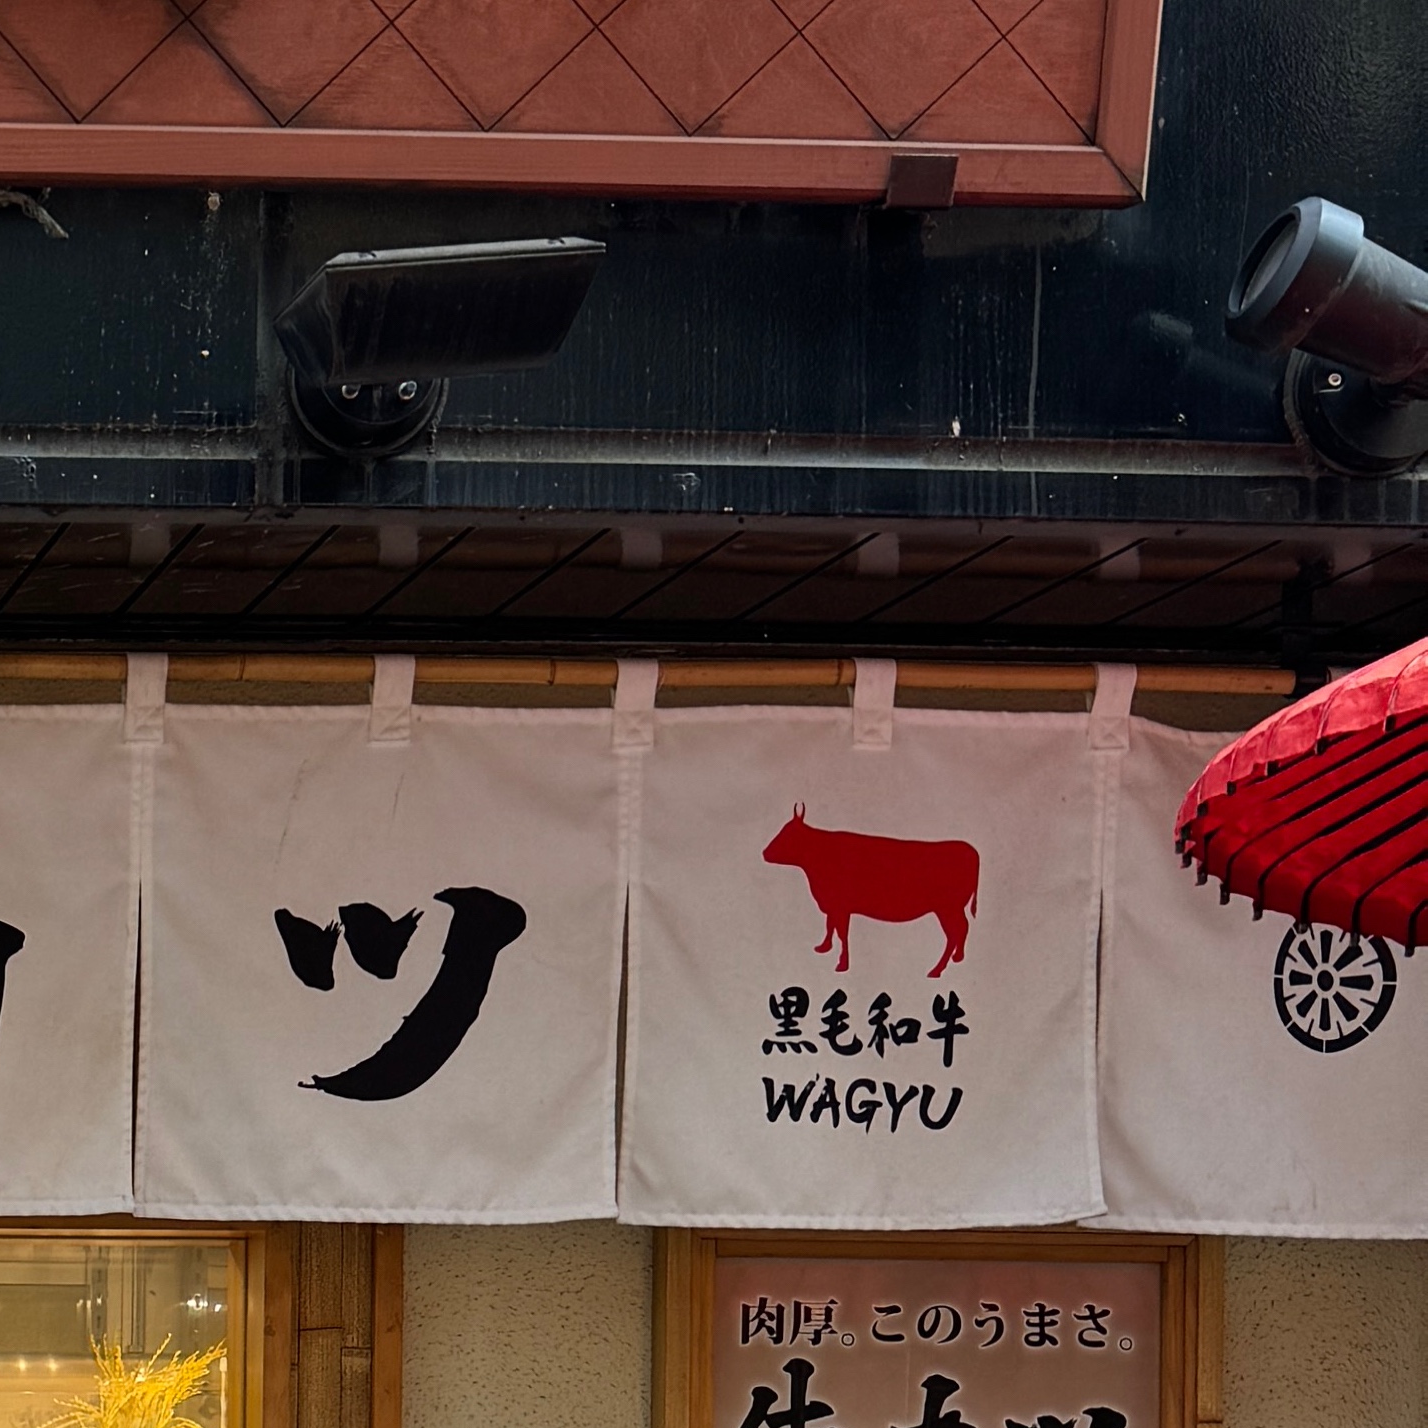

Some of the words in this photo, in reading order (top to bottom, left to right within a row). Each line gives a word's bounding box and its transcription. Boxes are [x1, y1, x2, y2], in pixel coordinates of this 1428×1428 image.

[760, 986, 971, 1068] 黒毛和牛
[761, 1070, 967, 1134] WAGYU
[739, 1298, 1134, 1352] 肉厚。このうまさ。
